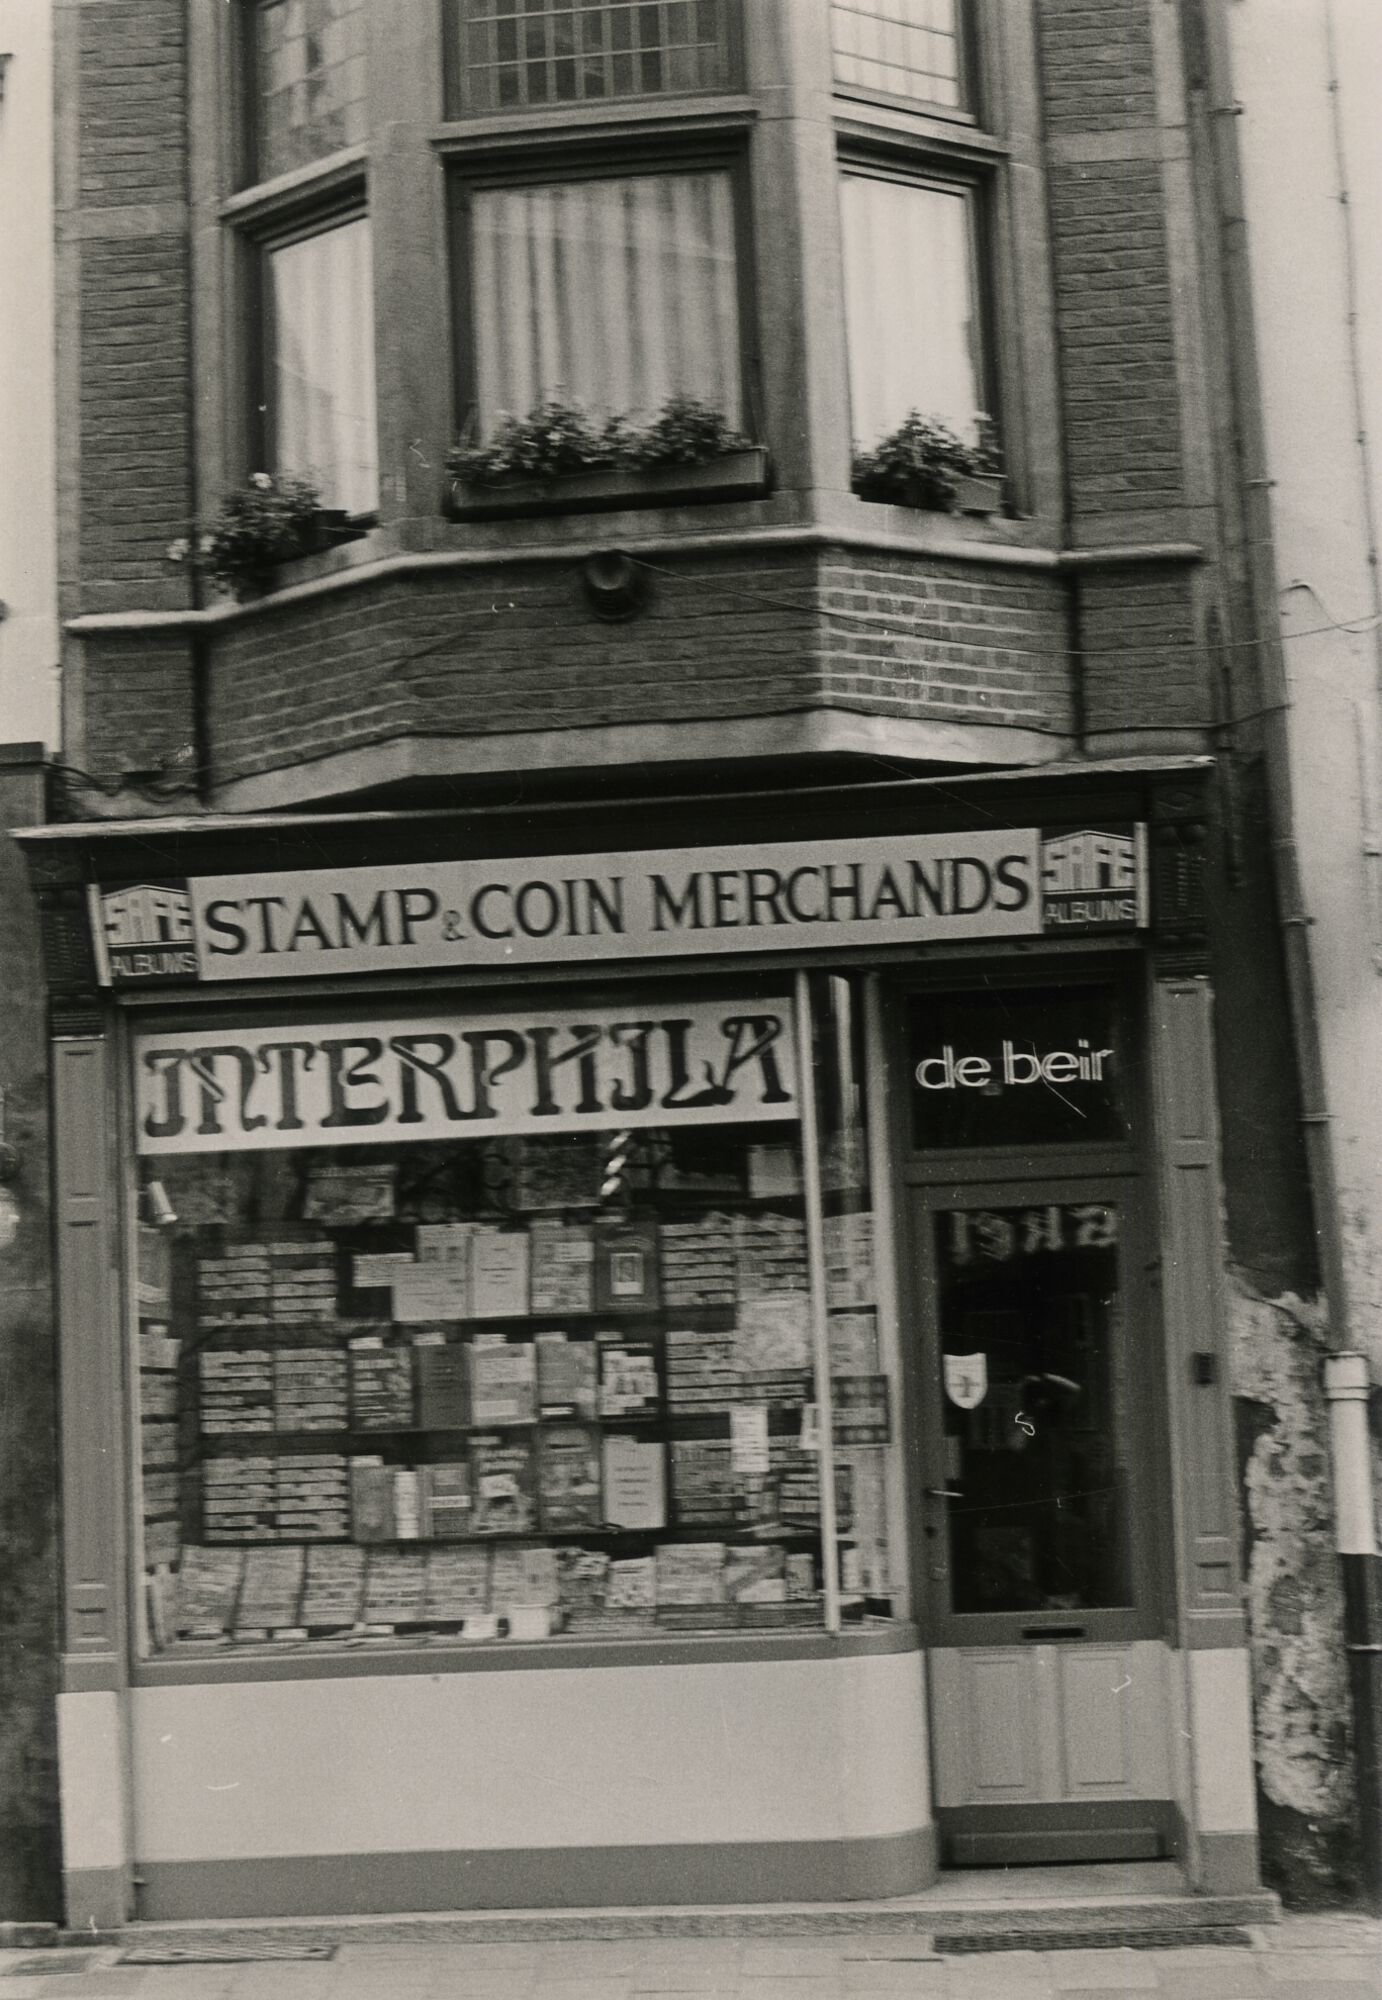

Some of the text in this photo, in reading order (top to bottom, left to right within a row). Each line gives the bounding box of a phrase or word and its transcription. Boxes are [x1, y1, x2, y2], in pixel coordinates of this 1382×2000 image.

[205, 887, 439, 956] STAMP
[471, 875, 627, 940] COIN
[651, 854, 1031, 931] MERCHANDS
[1043, 899, 1137, 924] ALBUMS
[110, 952, 197, 977] ALBUMS
[915, 1039, 1114, 1089] de beir
